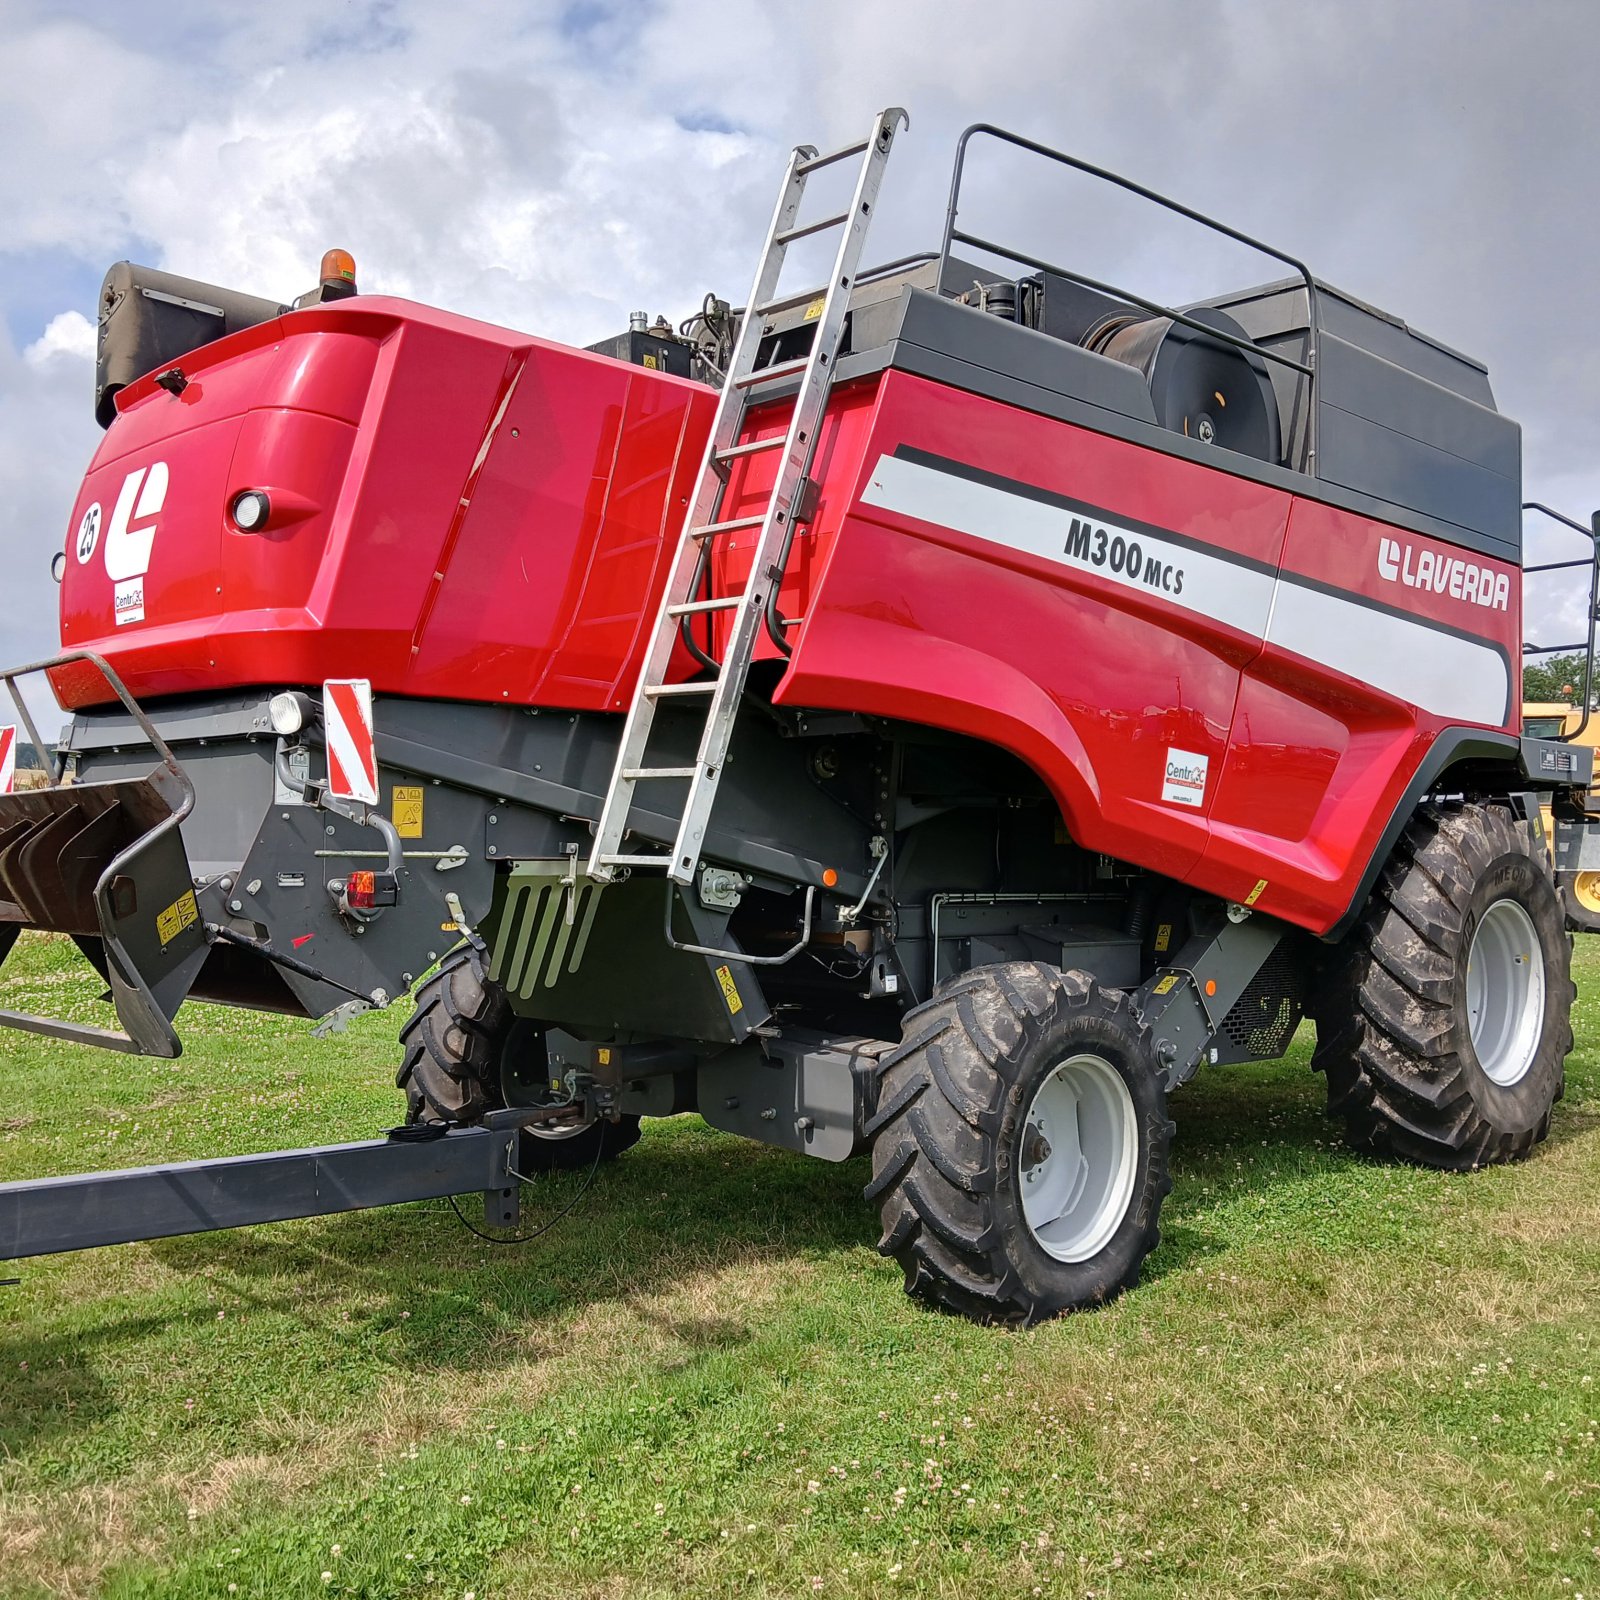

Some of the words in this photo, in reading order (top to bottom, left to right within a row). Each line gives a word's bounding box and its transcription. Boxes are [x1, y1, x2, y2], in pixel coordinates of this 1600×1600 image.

[79, 508, 98, 557] 25
[1063, 517, 1143, 579] M300
[1142, 557, 1184, 595] MCS
[1402, 544, 1510, 612] LAVERDA
